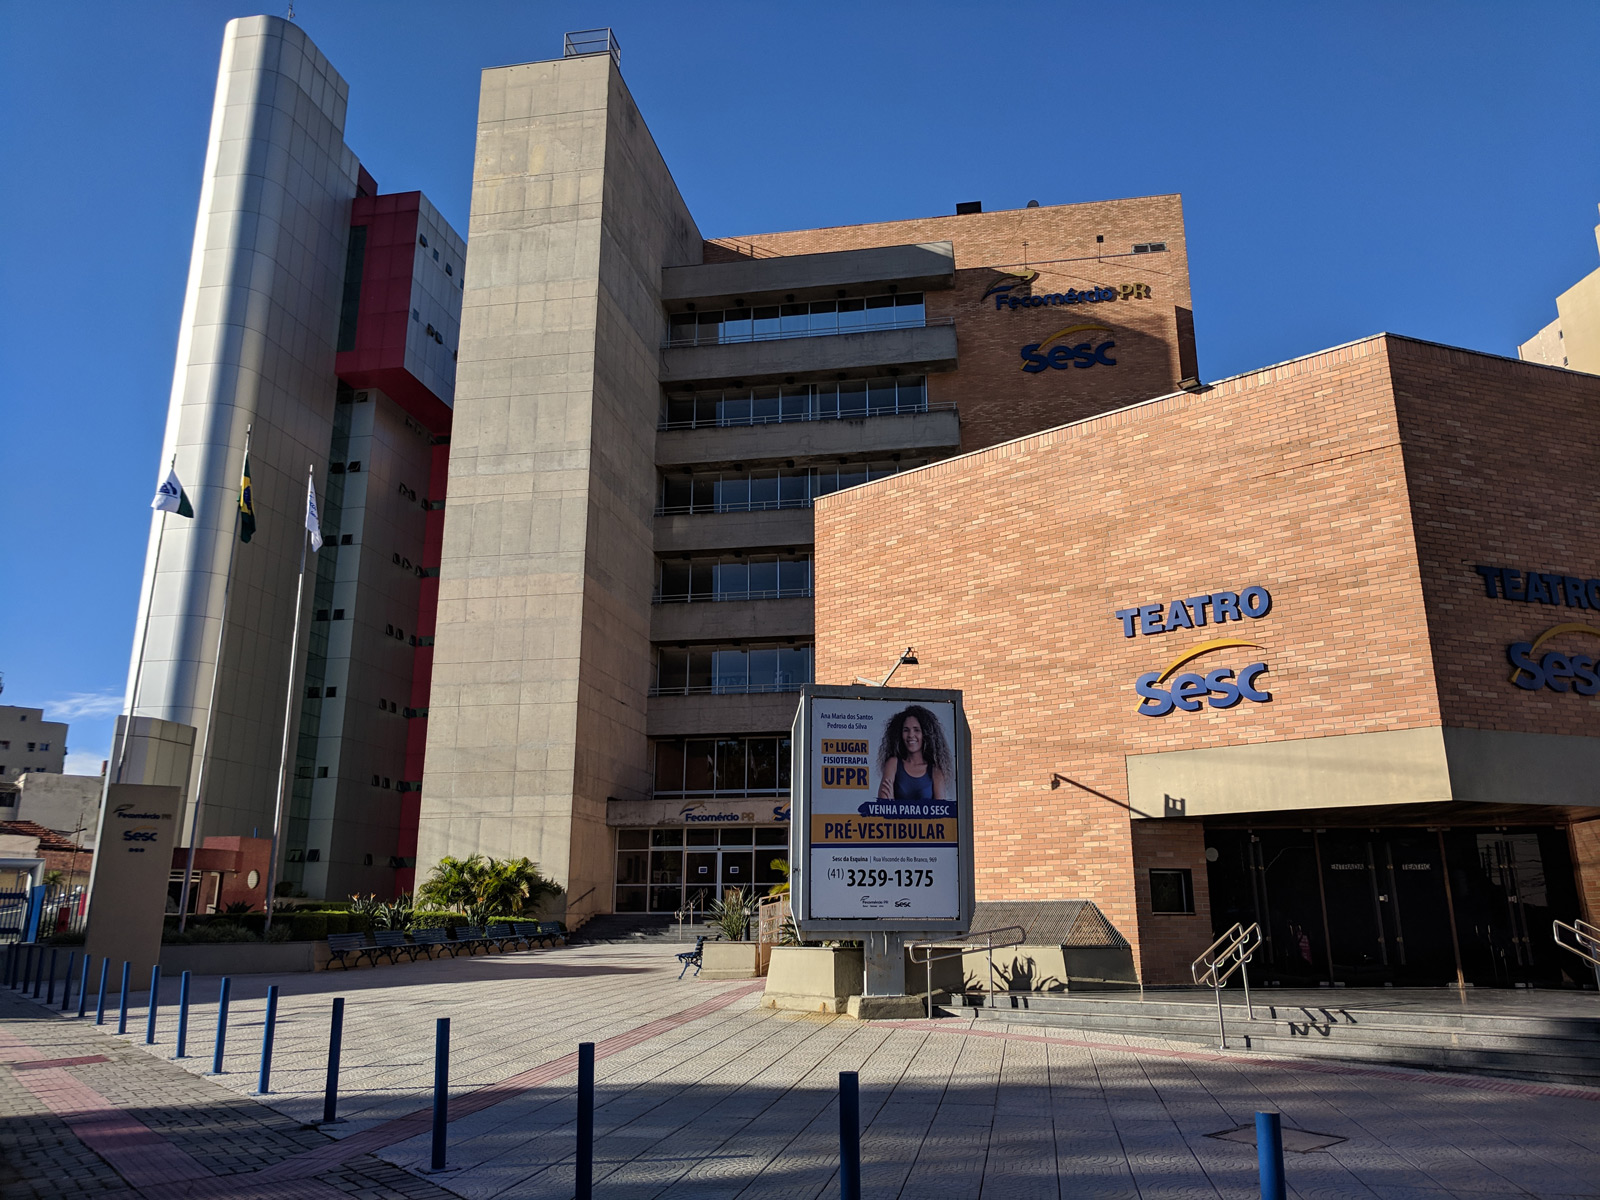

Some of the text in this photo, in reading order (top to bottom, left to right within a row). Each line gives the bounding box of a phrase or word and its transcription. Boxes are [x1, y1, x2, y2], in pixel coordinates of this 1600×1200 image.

[996, 282, 1150, 310] Fecomércio PR
[1115, 586, 1272, 638] TEATRO
[832, 713, 846, 721] Maria
[847, 713, 857, 721] dos
[827, 722, 847, 730] Pedroso
[836, 742, 867, 753] LUGAR
[823, 756, 868, 765] FISIOTERAPIA
[824, 767, 868, 786] UFPR
[868, 804, 950, 816] VENHA PARA O SESC
[685, 812, 755, 822] Fecomércio PR
[824, 820, 946, 840] PRÉ-VESTIBULAR
[827, 868, 934, 887] (41) 3259-1375
